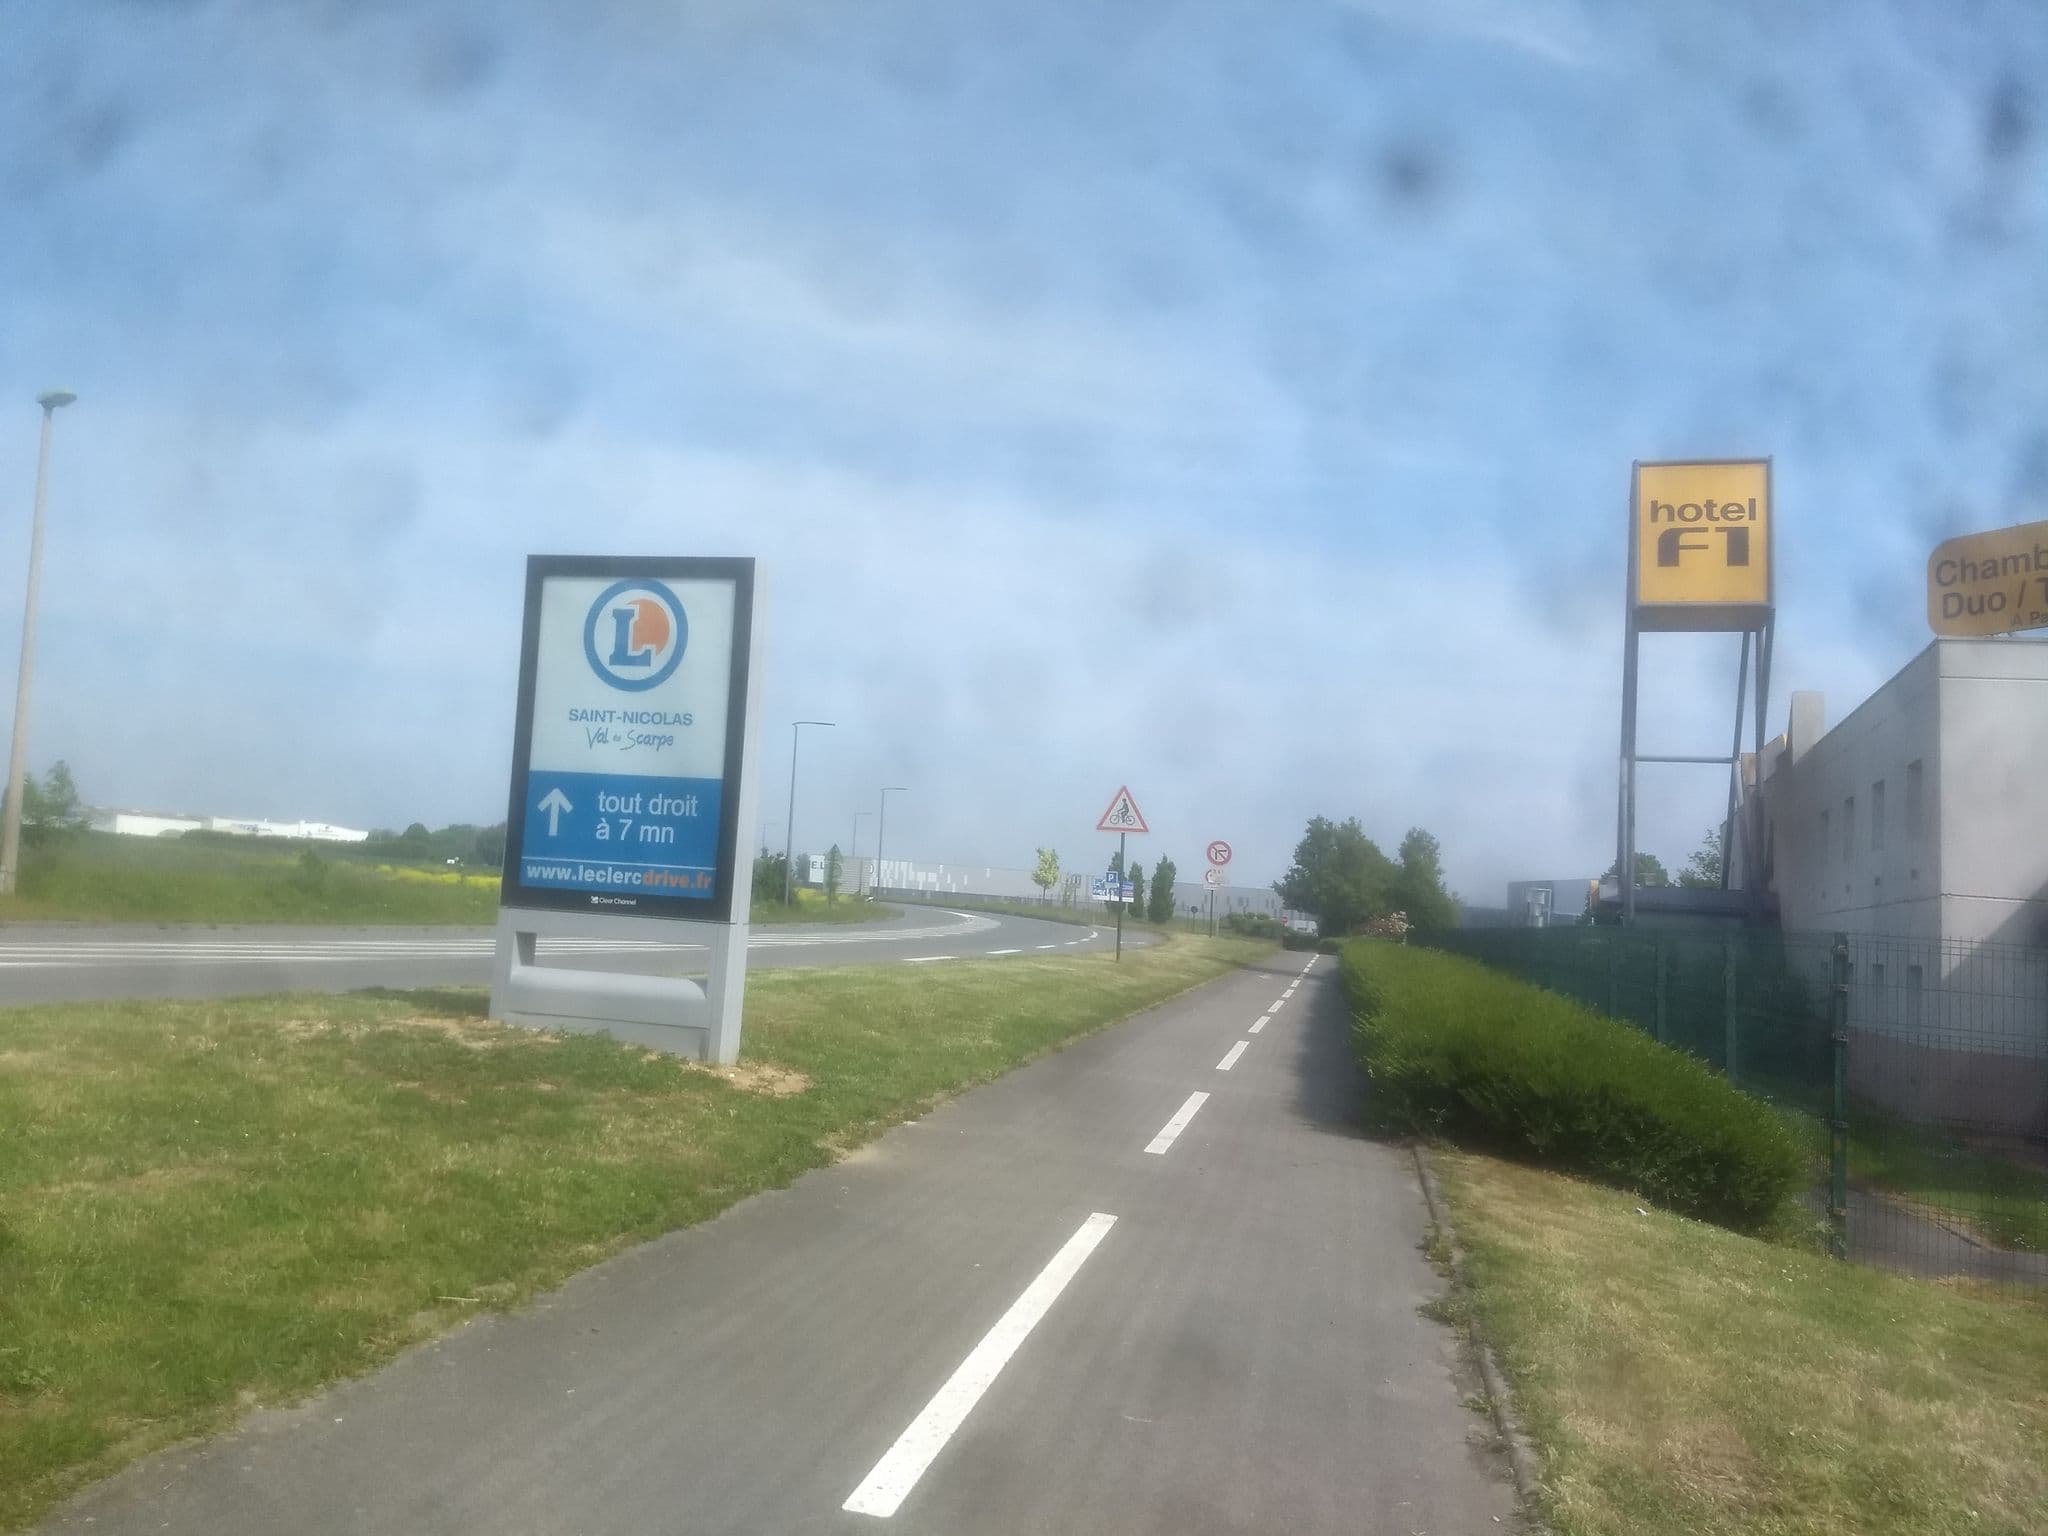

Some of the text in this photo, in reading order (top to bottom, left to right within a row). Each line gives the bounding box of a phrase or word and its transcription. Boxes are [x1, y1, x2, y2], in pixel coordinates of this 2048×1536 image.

[1650, 498, 1757, 523] hotel
[1657, 526, 1749, 567] F1
[1942, 591, 2007, 619] Duo
[568, 708, 694, 726] SAINT-NICOLAS
[585, 726, 610, 750] Val
[619, 729, 674, 752] Scarpe
[598, 790, 699, 817] tout droit
[595, 818, 675, 844] à 7 mn
[526, 863, 712, 889] www.leclercdrive.fr
